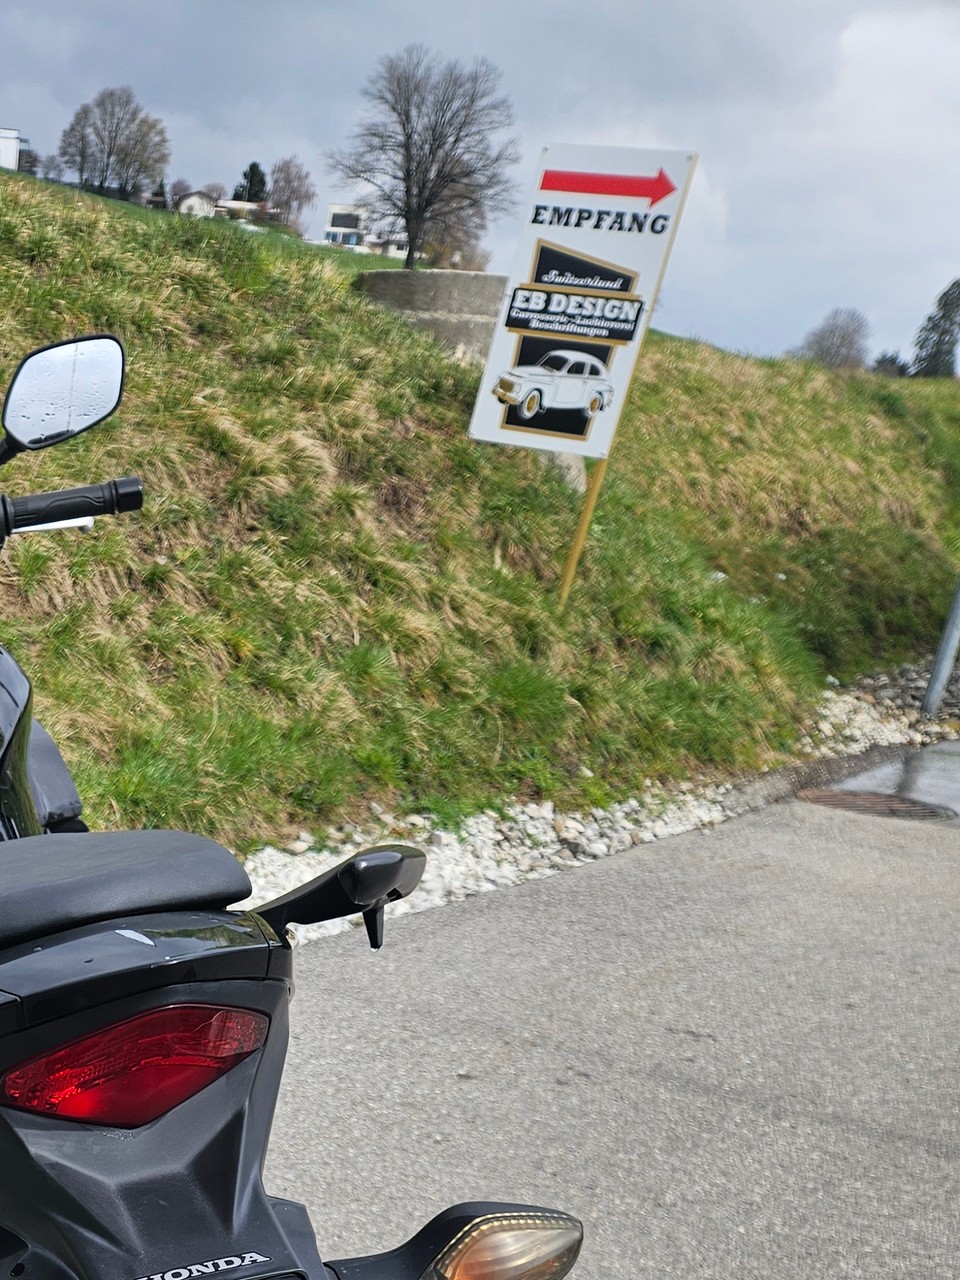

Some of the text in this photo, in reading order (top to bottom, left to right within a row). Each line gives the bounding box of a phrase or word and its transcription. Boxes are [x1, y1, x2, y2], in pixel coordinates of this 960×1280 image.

[531, 205, 670, 234] EMPFANG
[512, 289, 642, 321] EB DESIGN
